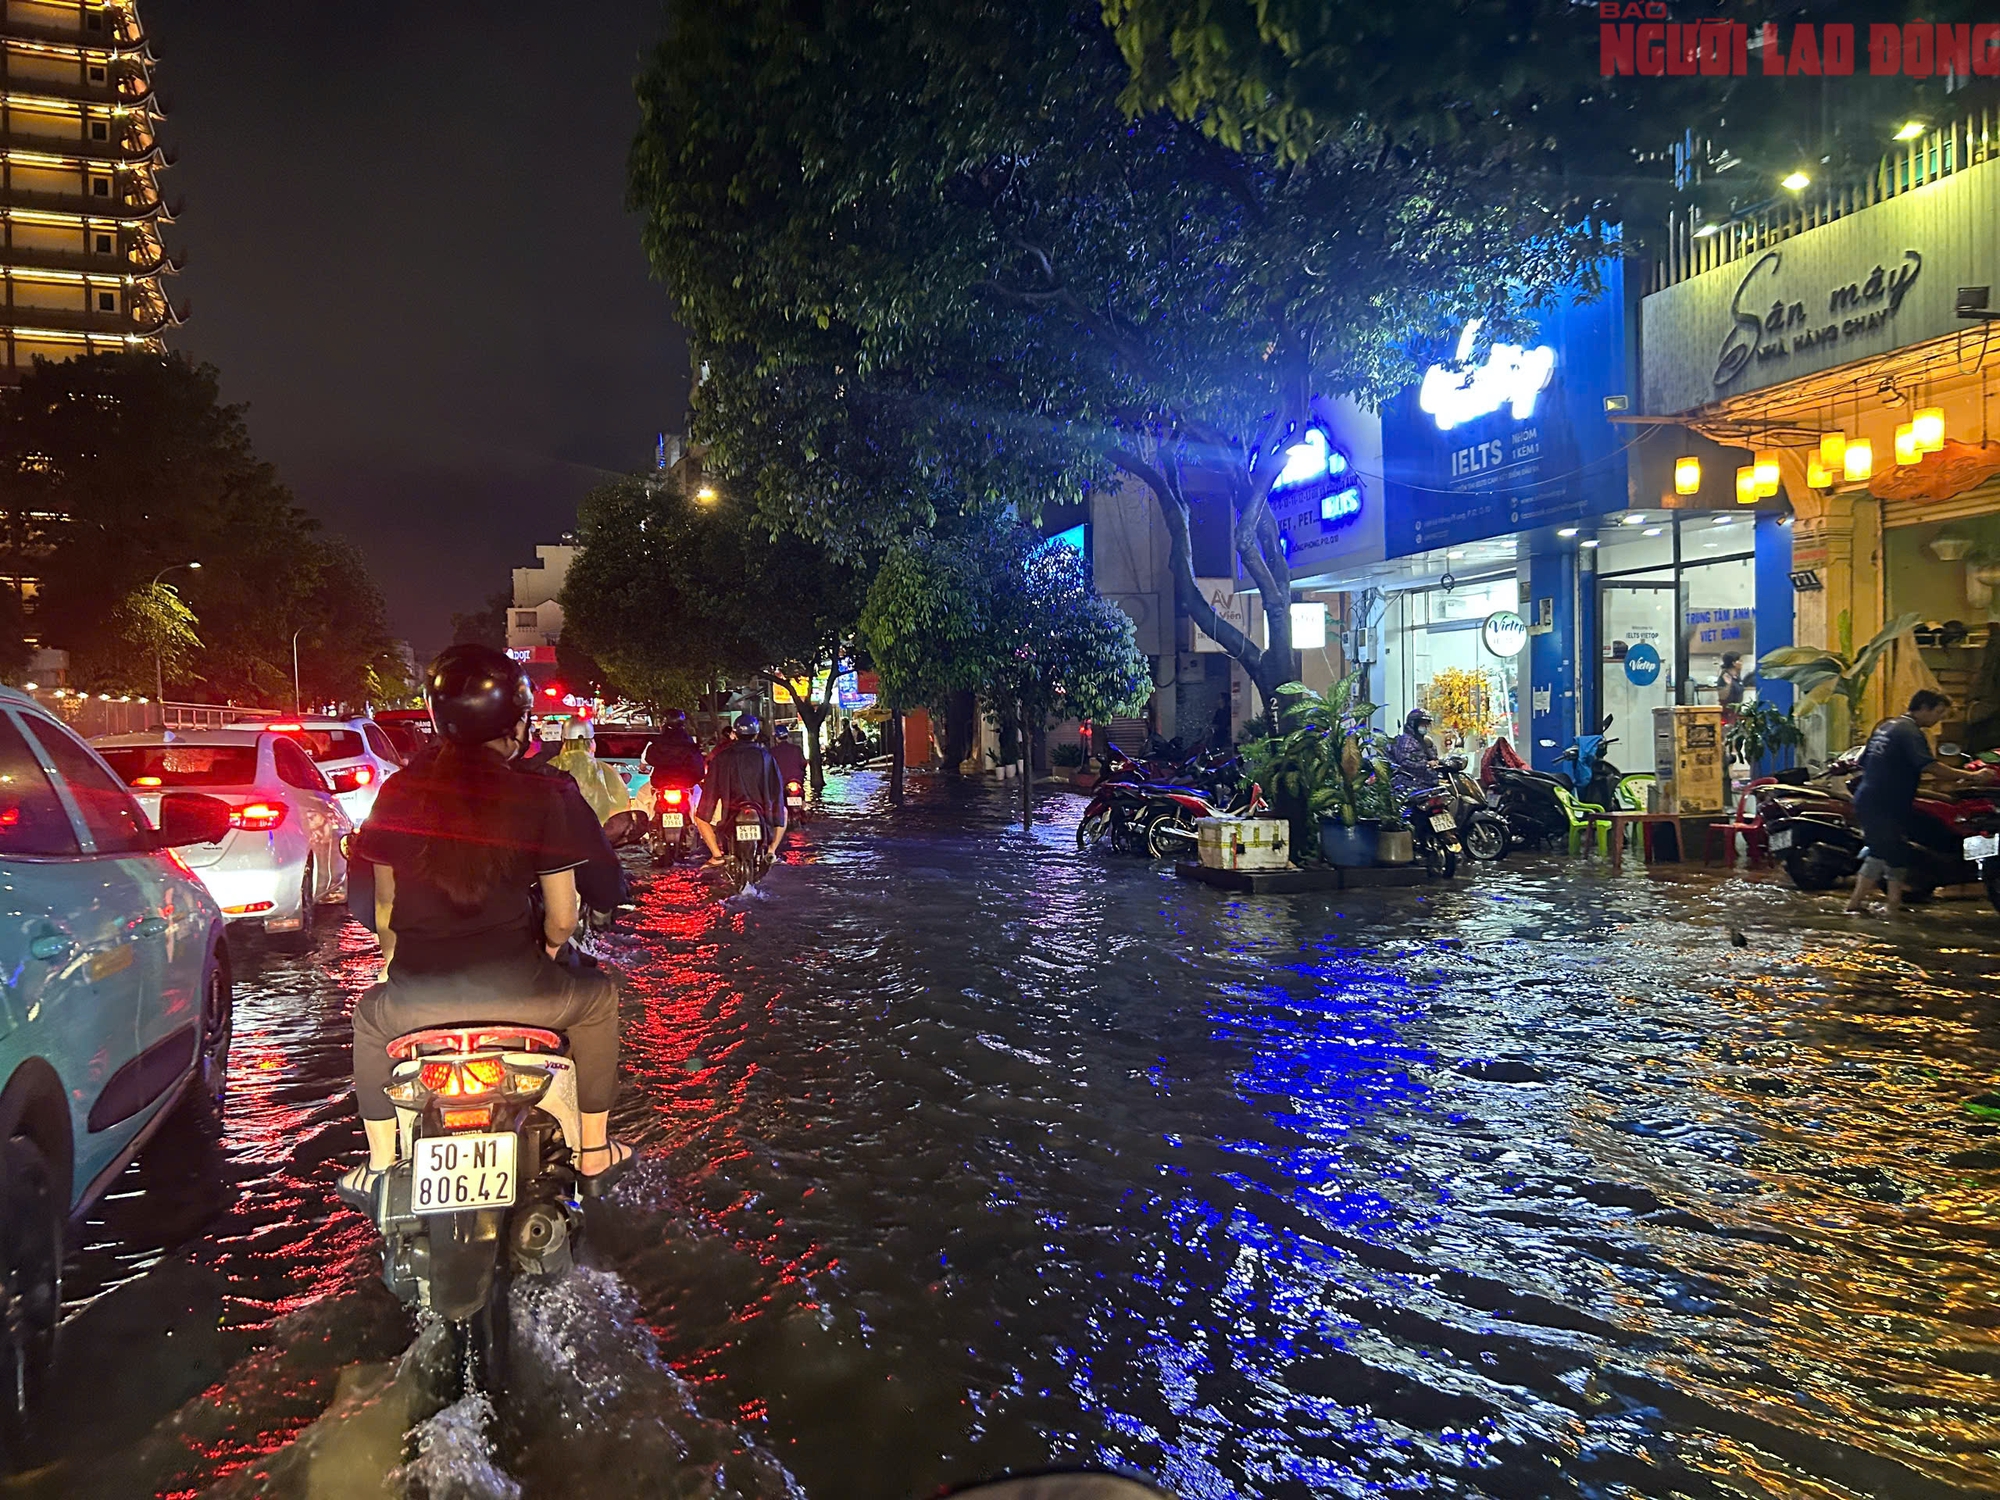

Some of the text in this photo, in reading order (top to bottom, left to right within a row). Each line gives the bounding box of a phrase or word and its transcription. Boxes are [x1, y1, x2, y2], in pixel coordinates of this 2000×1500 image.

[1713, 248, 1922, 386] Sân mây
[1793, 323, 1838, 349] HÀNG
[1842, 309, 1887, 337] CHAY
[1451, 438, 1503, 477] IELTS
[1685, 611, 1711, 625] TRUNG
[1713, 608, 1730, 622] TÂM
[1733, 607, 1750, 620] ANH
[430, 1140, 497, 1172] 50-N1
[419, 1172, 509, 1205] 806.42
